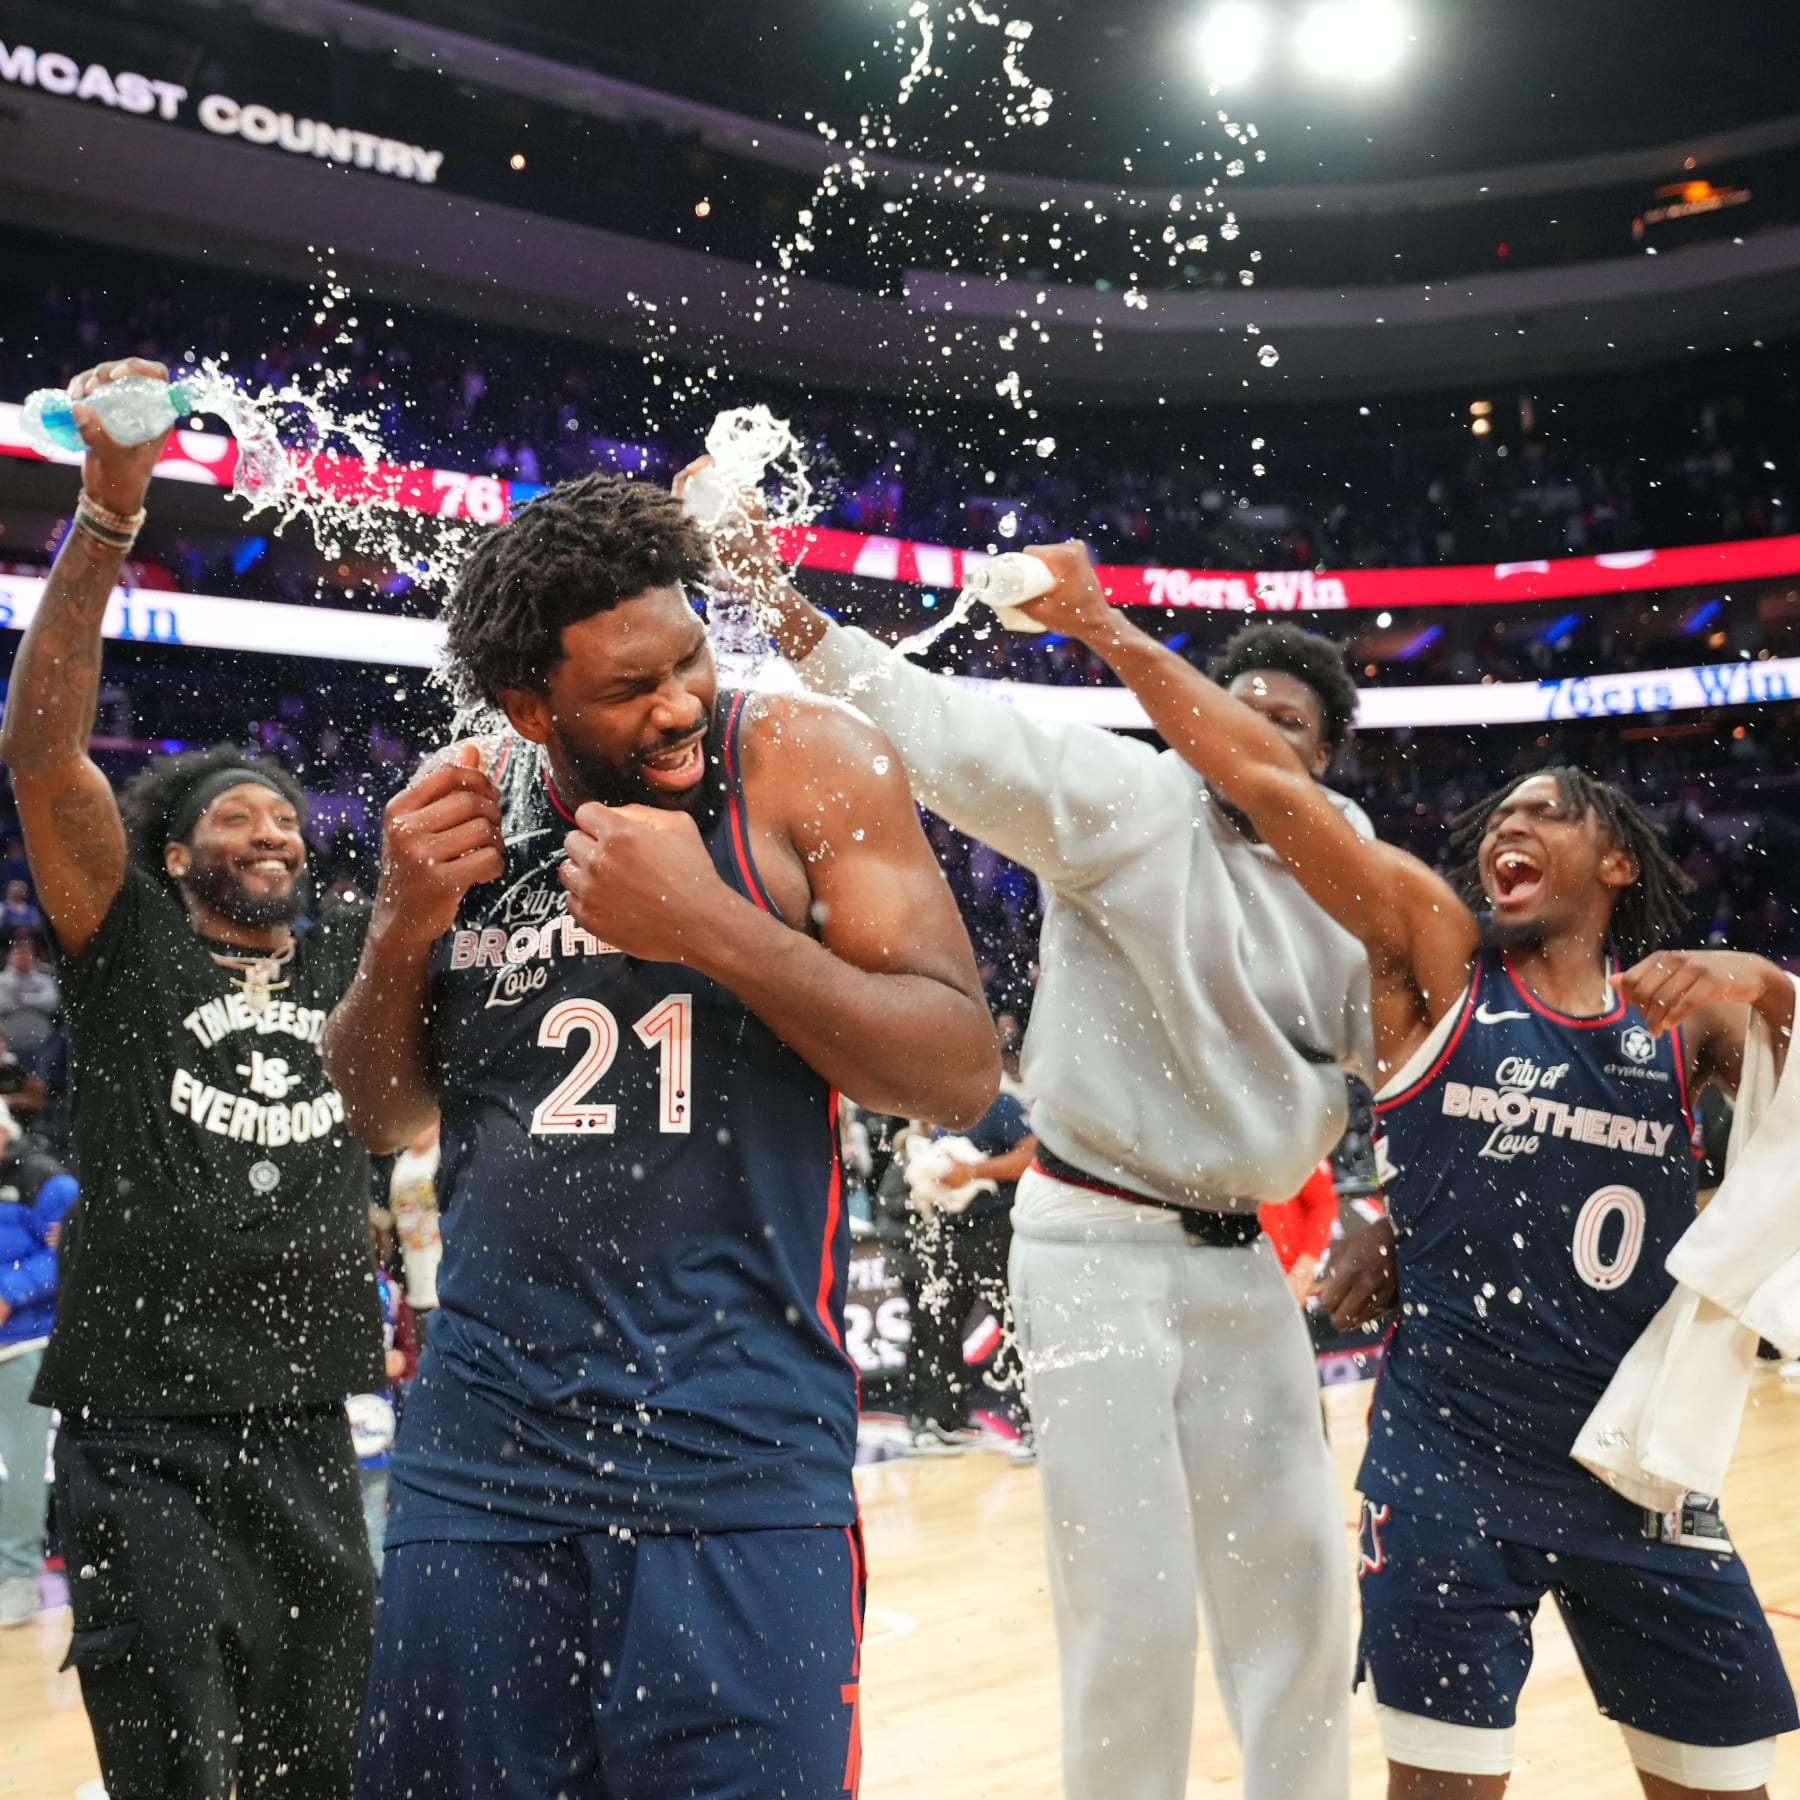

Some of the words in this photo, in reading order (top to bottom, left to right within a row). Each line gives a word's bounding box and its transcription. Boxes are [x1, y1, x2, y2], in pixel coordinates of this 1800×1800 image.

[198, 94, 444, 183] COUNTRY
[432, 470, 504, 522] 76
[1143, 568, 1250, 609] 76ers
[1254, 570, 1348, 611] Win
[1537, 676, 1674, 721] 76ers
[1690, 661, 1793, 706] Win
[502, 881, 552, 930] City
[484, 960, 549, 1010] Love
[530, 993, 692, 1134] 21
[1494, 1056, 1542, 1093] City
[1540, 1062, 1570, 1090] of
[1441, 1081, 1675, 1157] BROTHERLY
[1477, 1122, 1541, 1161] Love
[1571, 1184, 1647, 1291] 0
